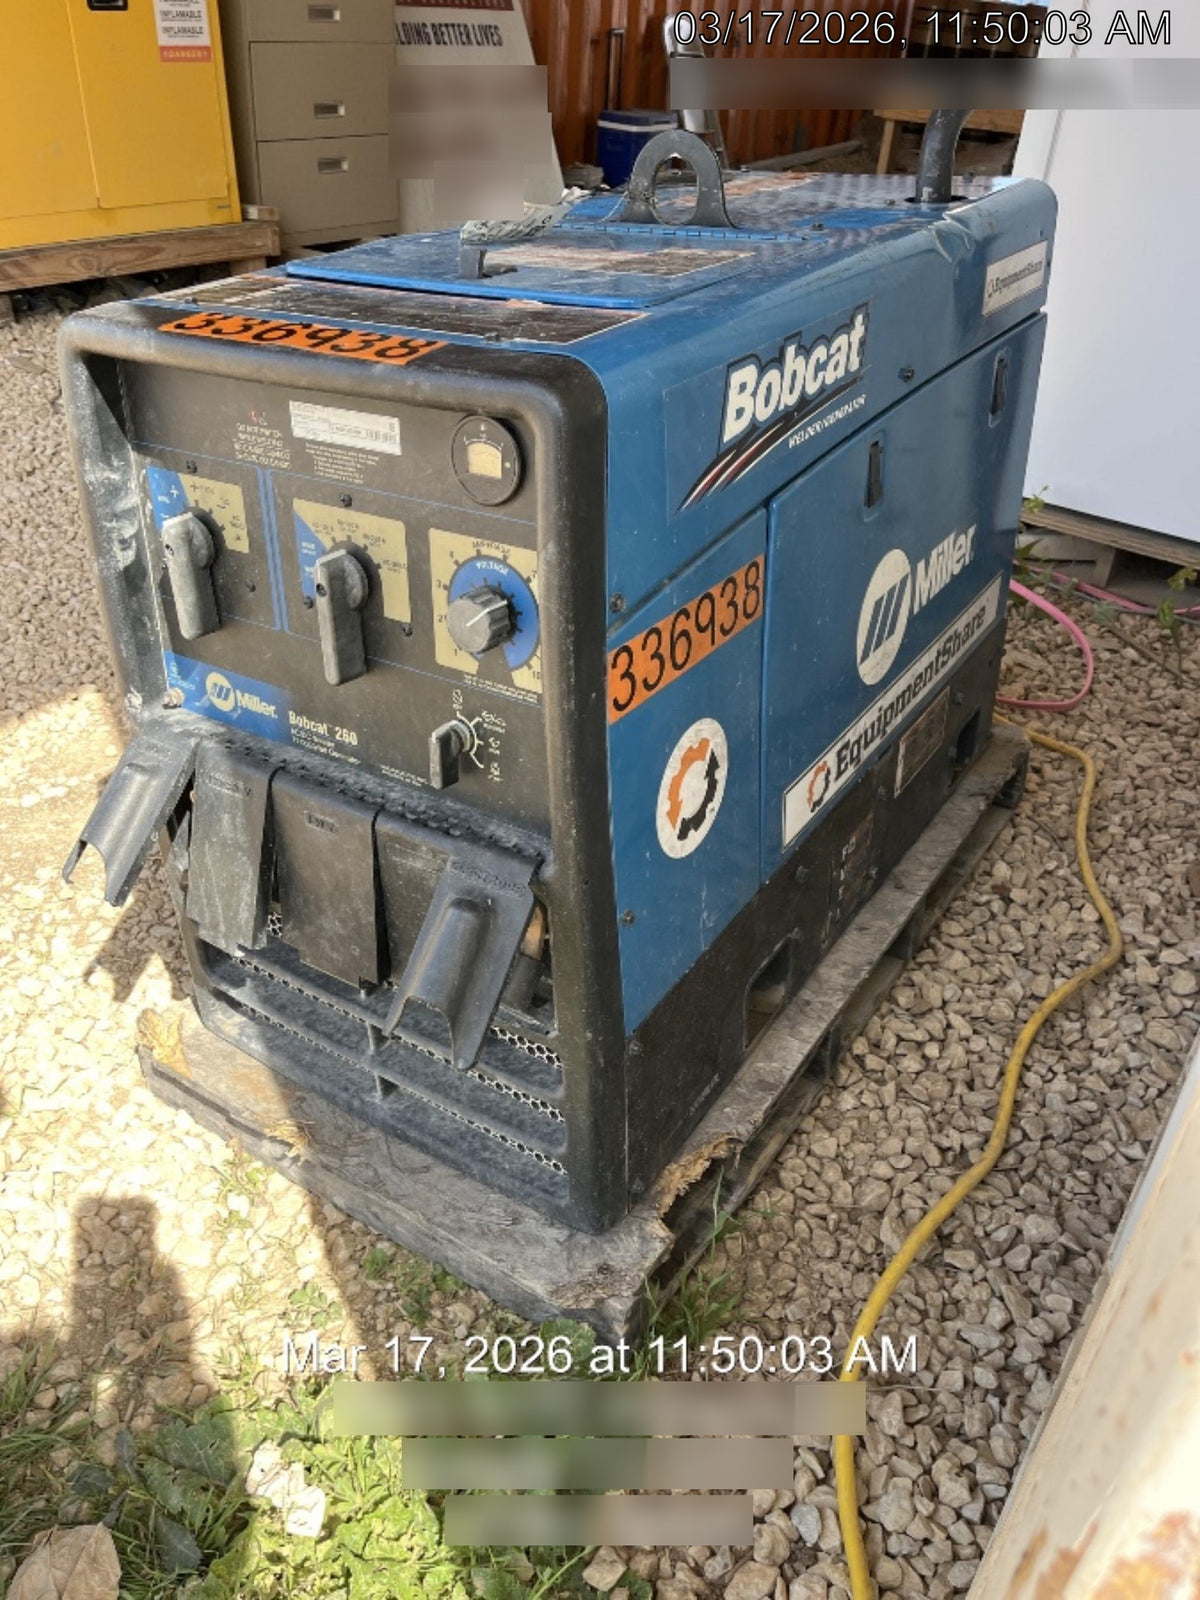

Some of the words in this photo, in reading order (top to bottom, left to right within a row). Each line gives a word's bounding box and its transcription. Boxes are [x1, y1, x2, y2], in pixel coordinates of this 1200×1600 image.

[430, 22, 473, 46] BETTER
[471, 23, 503, 47] LIVES
[173, 311, 438, 359] 336938
[721, 311, 867, 446] Bobcat
[912, 522, 979, 616] Miller
[610, 559, 761, 713] 336938
[235, 688, 277, 718] Miller
[288, 710, 330, 737] Bobcat
[334, 726, 359, 746] 260
[833, 605, 987, 783] EquipmentShare
